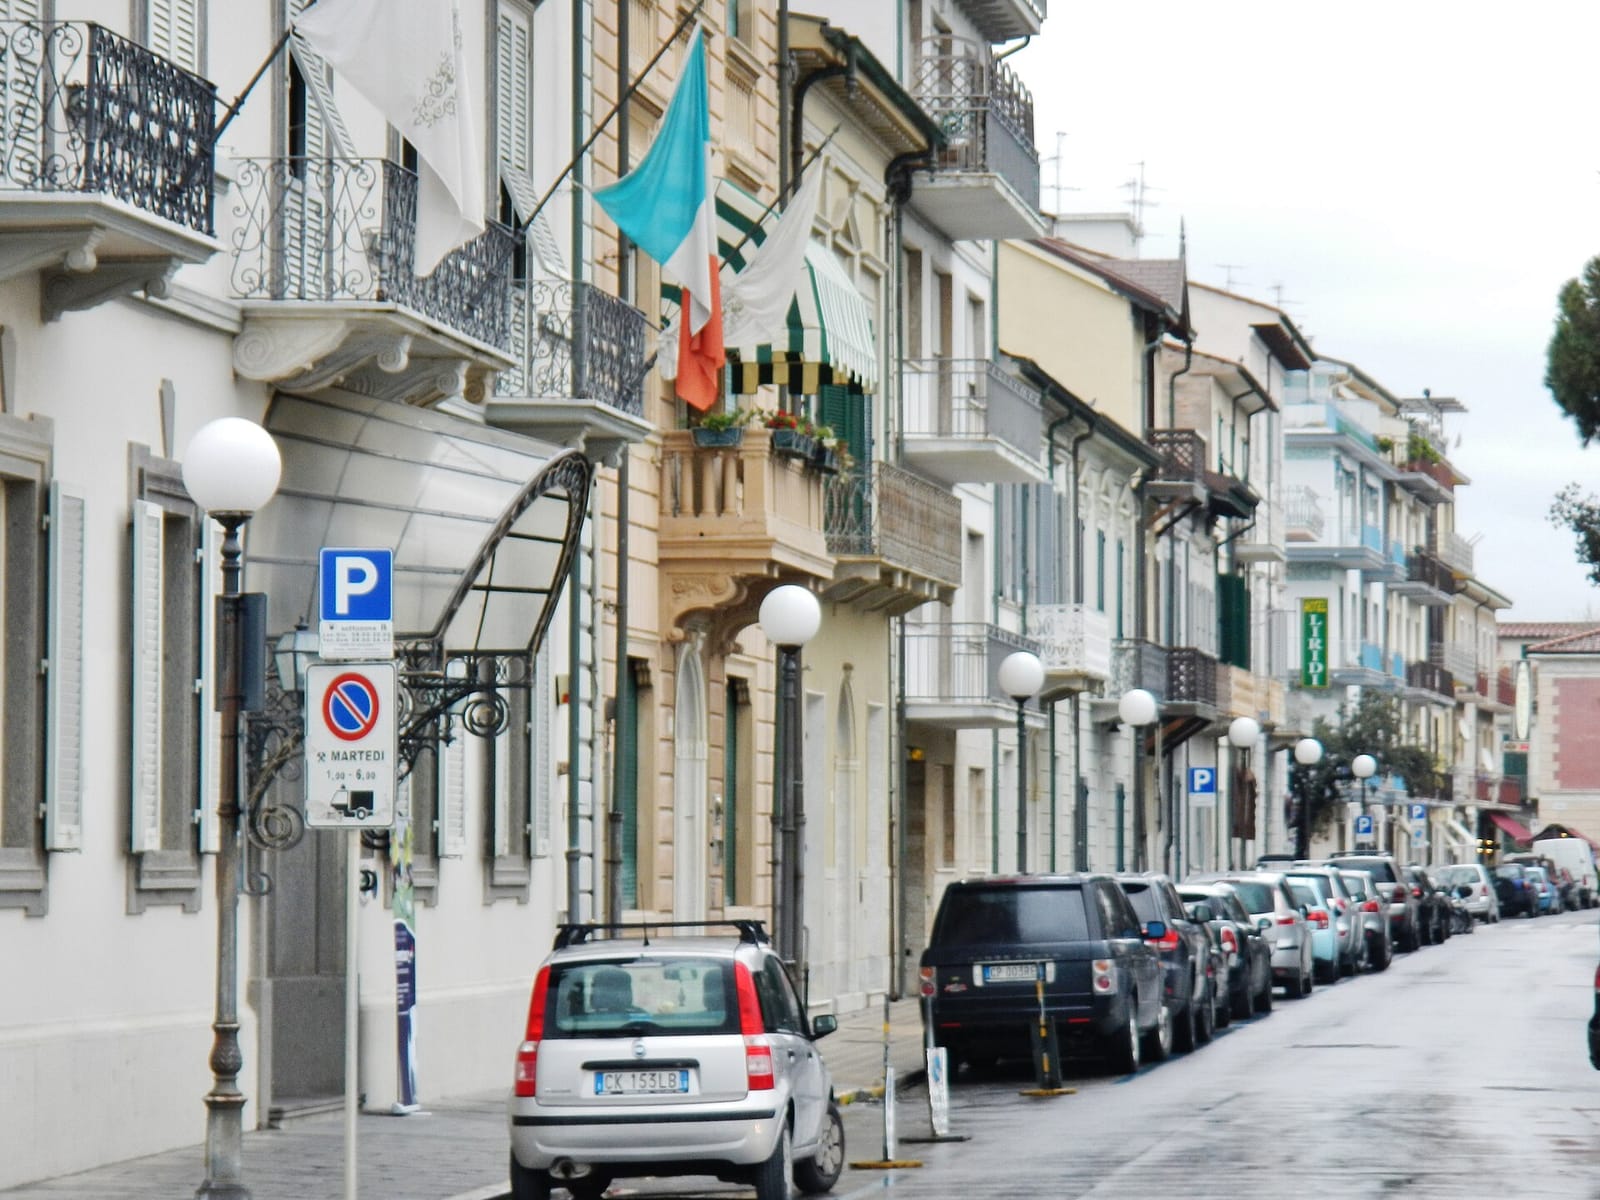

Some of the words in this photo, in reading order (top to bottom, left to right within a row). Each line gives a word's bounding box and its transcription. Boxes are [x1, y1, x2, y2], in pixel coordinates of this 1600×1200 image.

[335, 556, 379, 615] P
[1308, 613, 1324, 686] LIRIDI
[330, 750, 385, 761] MARTEDI
[1194, 769, 1211, 791] P
[1412, 805, 1423, 819] P
[1359, 817, 1371, 832] P
